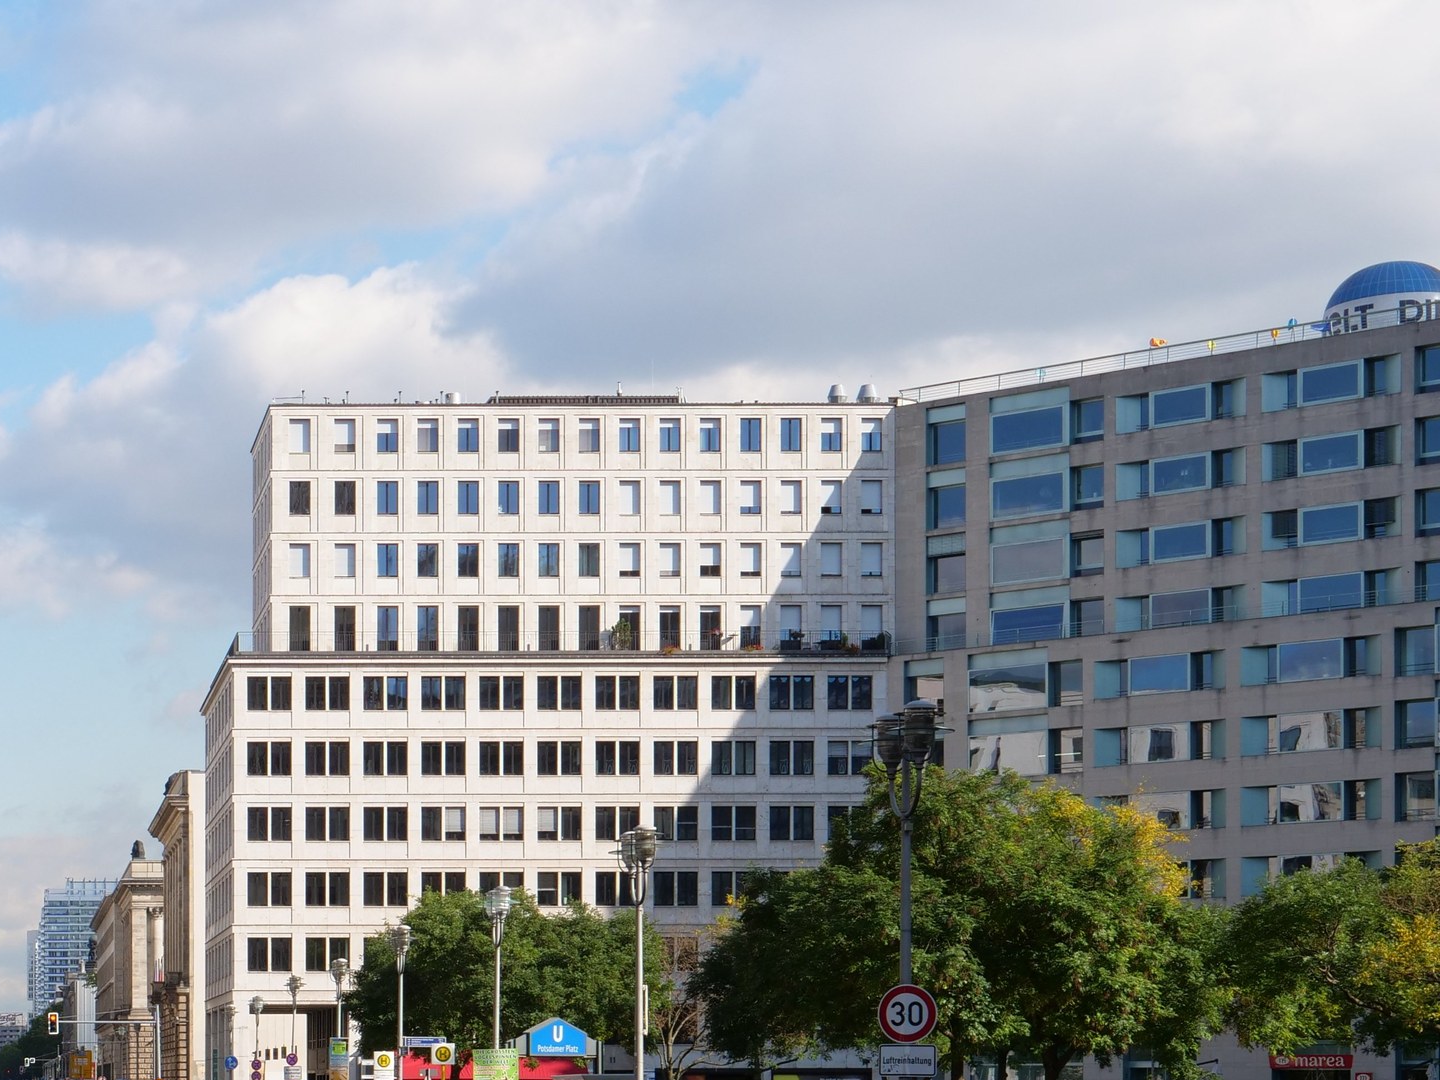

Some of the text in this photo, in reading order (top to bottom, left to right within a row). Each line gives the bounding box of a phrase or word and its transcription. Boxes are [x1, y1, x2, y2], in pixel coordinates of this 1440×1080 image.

[891, 1001, 923, 1026] 30
[553, 1025, 564, 1042] U
[537, 1045, 578, 1053] Potsdamer Platz
[883, 1057, 932, 1066] Luftreinhaltung
[1294, 1056, 1345, 1067] marea
